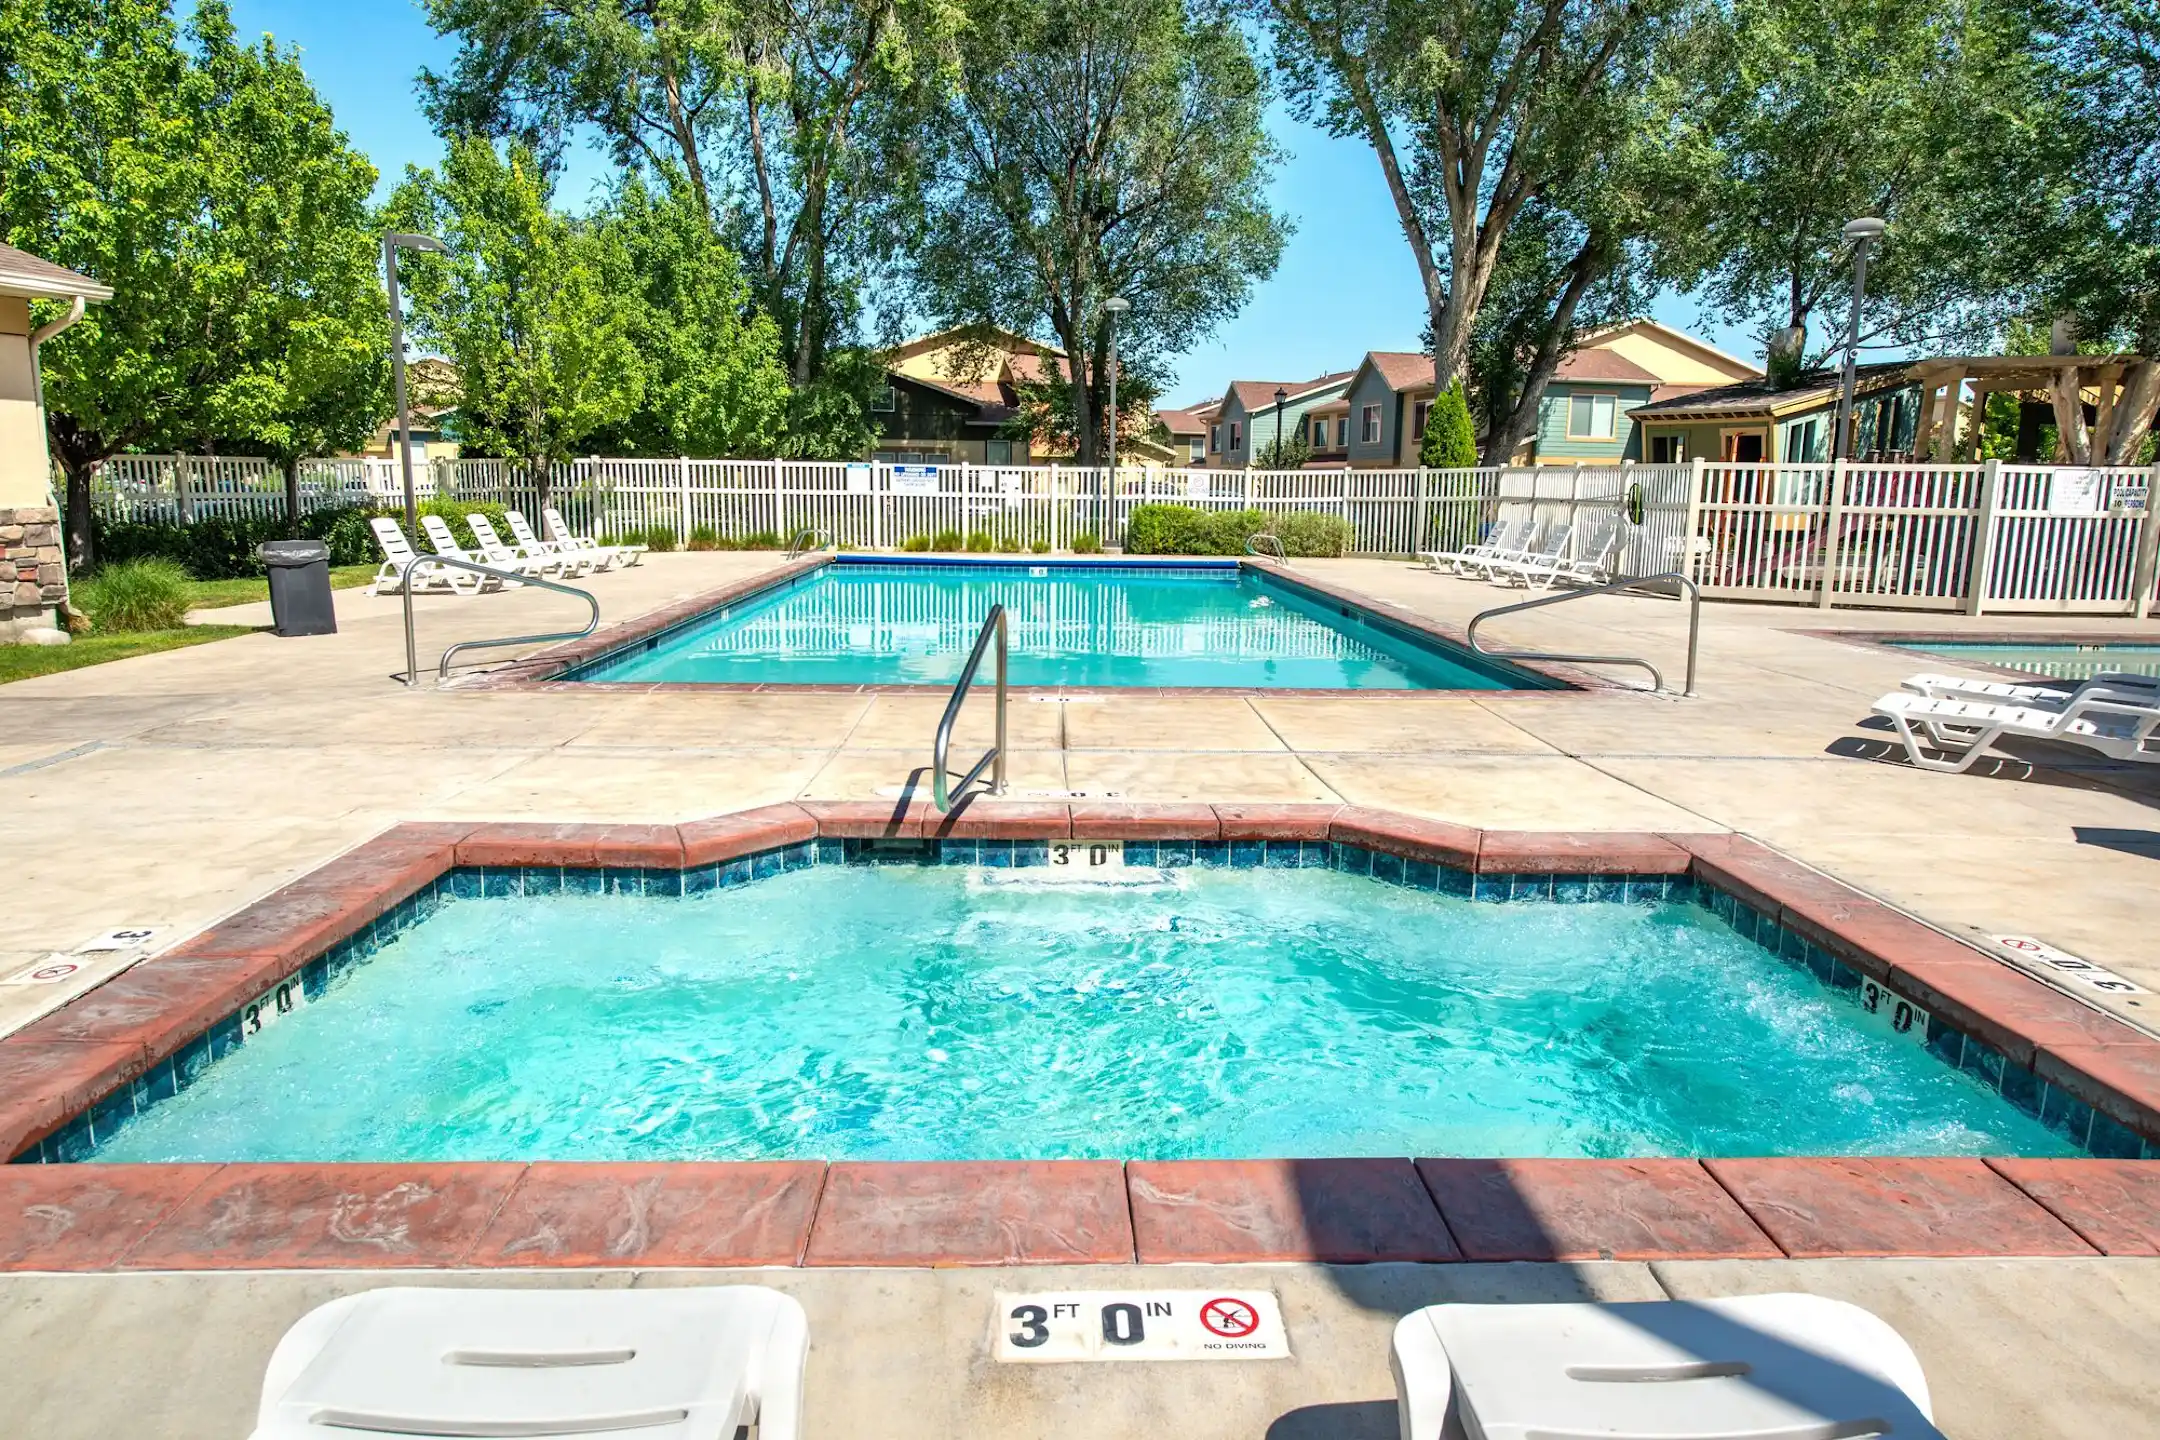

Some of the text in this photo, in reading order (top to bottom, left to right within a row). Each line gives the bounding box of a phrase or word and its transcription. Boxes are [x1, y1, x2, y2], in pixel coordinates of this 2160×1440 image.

[1053, 844, 1119, 866] 3 FT 0 IN
[245, 1004, 261, 1035] 3
[1864, 982, 1879, 1014] 3
[1893, 1001, 1913, 1033] 0
[1009, 1302, 1173, 1348] 3 FT 0 IN
[1225, 1342, 1267, 1350] DIVING
